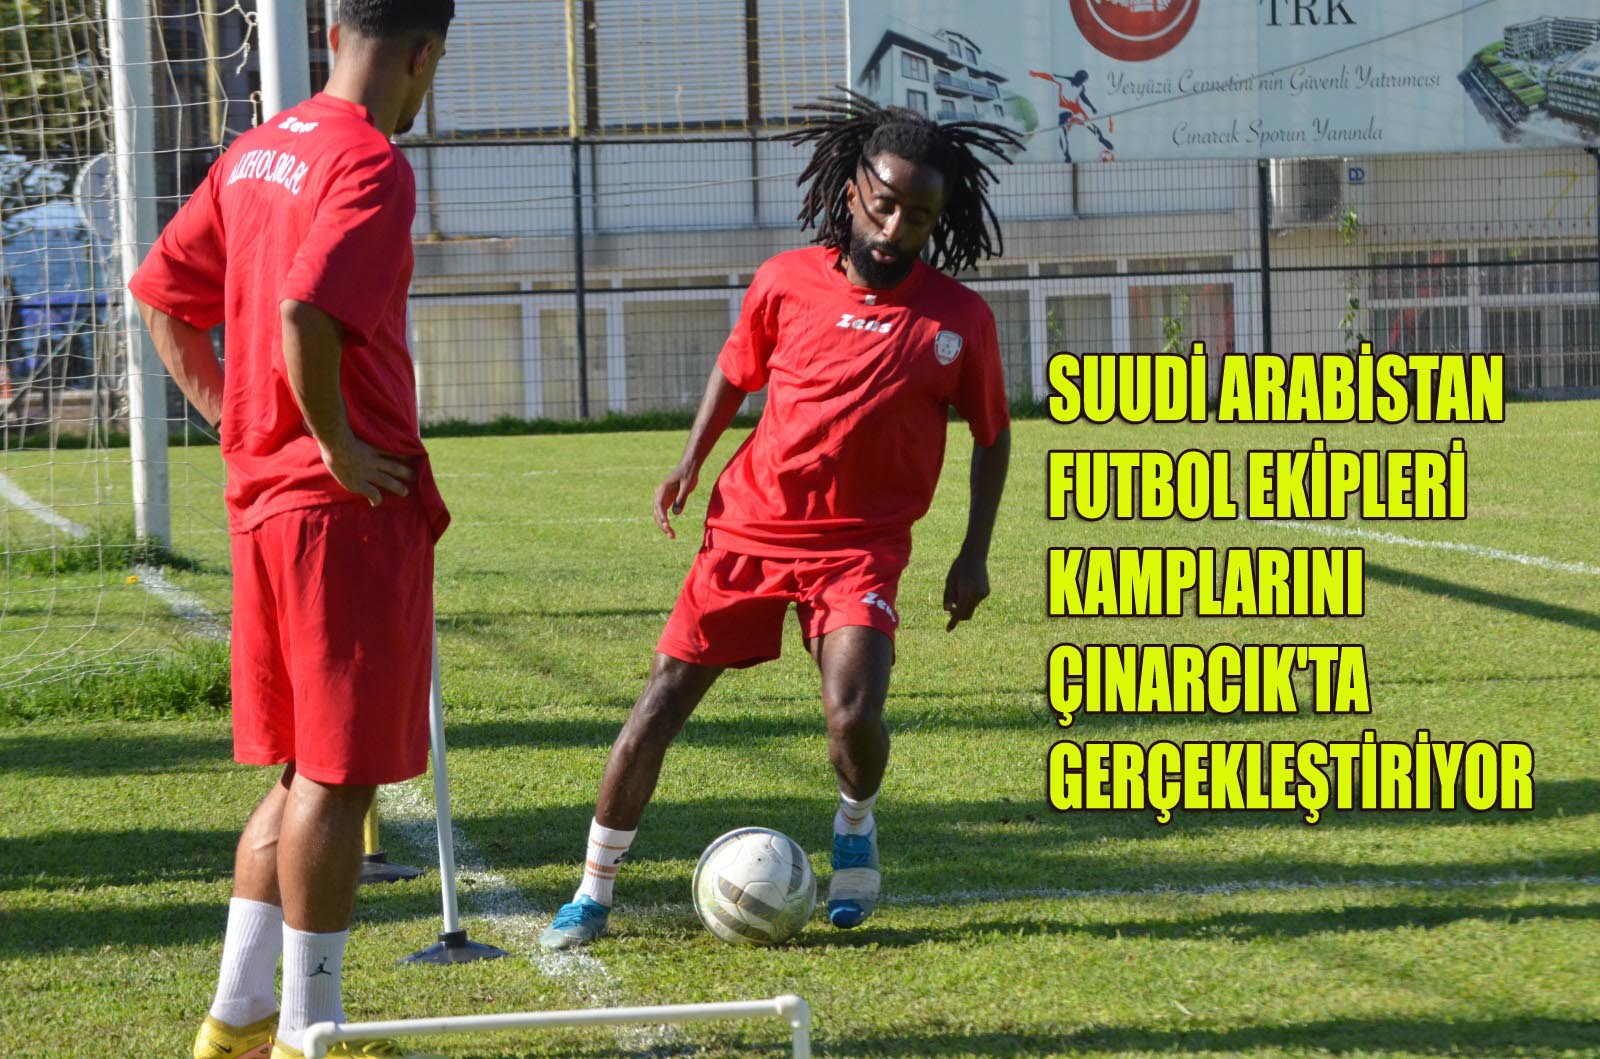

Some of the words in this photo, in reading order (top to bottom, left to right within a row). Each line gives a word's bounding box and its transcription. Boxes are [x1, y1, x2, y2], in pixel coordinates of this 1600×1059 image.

[1259, 0, 1357, 26] TRK
[1106, 71, 1172, 101] Yeryüzü
[1290, 64, 1349, 97] Güvenli
[1245, 118, 1305, 149] Sporun
[1311, 116, 1383, 142] Yanında
[835, 313, 893, 333] Zeus
